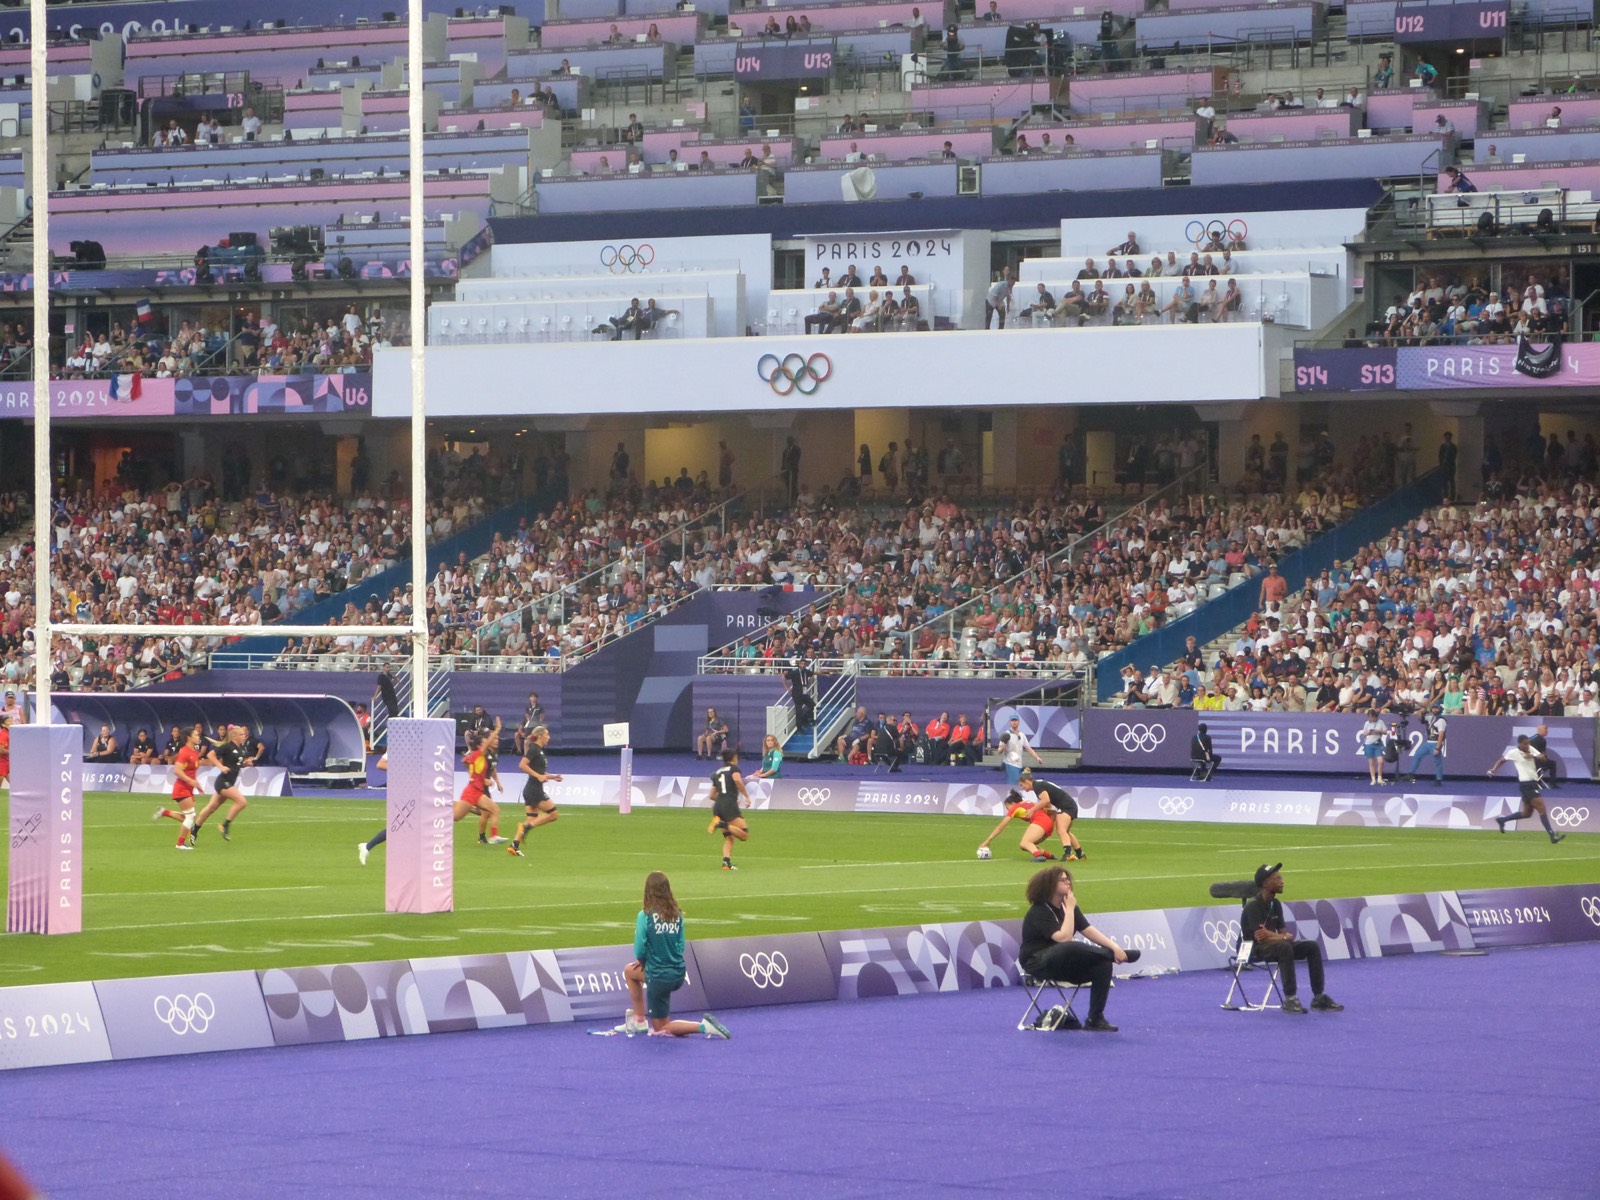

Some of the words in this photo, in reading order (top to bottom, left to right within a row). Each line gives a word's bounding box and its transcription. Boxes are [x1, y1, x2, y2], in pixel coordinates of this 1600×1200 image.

[1396, 16, 1424, 32] U12
[1480, 11, 1506, 28] U11
[736, 56, 760, 72] U14
[804, 53, 831, 69] U13
[816, 242, 881, 260] PARIS
[892, 240, 951, 258] 2024
[1361, 364, 1394, 384] S13
[1427, 357, 1499, 376] PARIS
[1297, 366, 1328, 385] S14
[58, 390, 107, 406] 2024
[346, 392, 367, 406] U6
[727, 615, 770, 628] PARIS
[1241, 728, 1339, 755] PARIS
[98, 772, 127, 783] 2024
[434, 745, 446, 807] 2024
[719, 774, 727, 793] 1
[61, 754, 72, 821] 2024
[565, 786, 596, 796] 2024
[864, 793, 901, 803] PARIS
[905, 794, 939, 805] 2024
[1230, 802, 1270, 814] PARIS
[1275, 804, 1311, 814] 2024
[433, 818, 445, 887] PARIS
[60, 832, 71, 907] PARIS
[1473, 909, 1513, 926] PARIS
[1515, 906, 1550, 923] 2024
[654, 923, 679, 934] 2024
[1124, 933, 1166, 950] 2024
[25, 1012, 90, 1037] 2024
